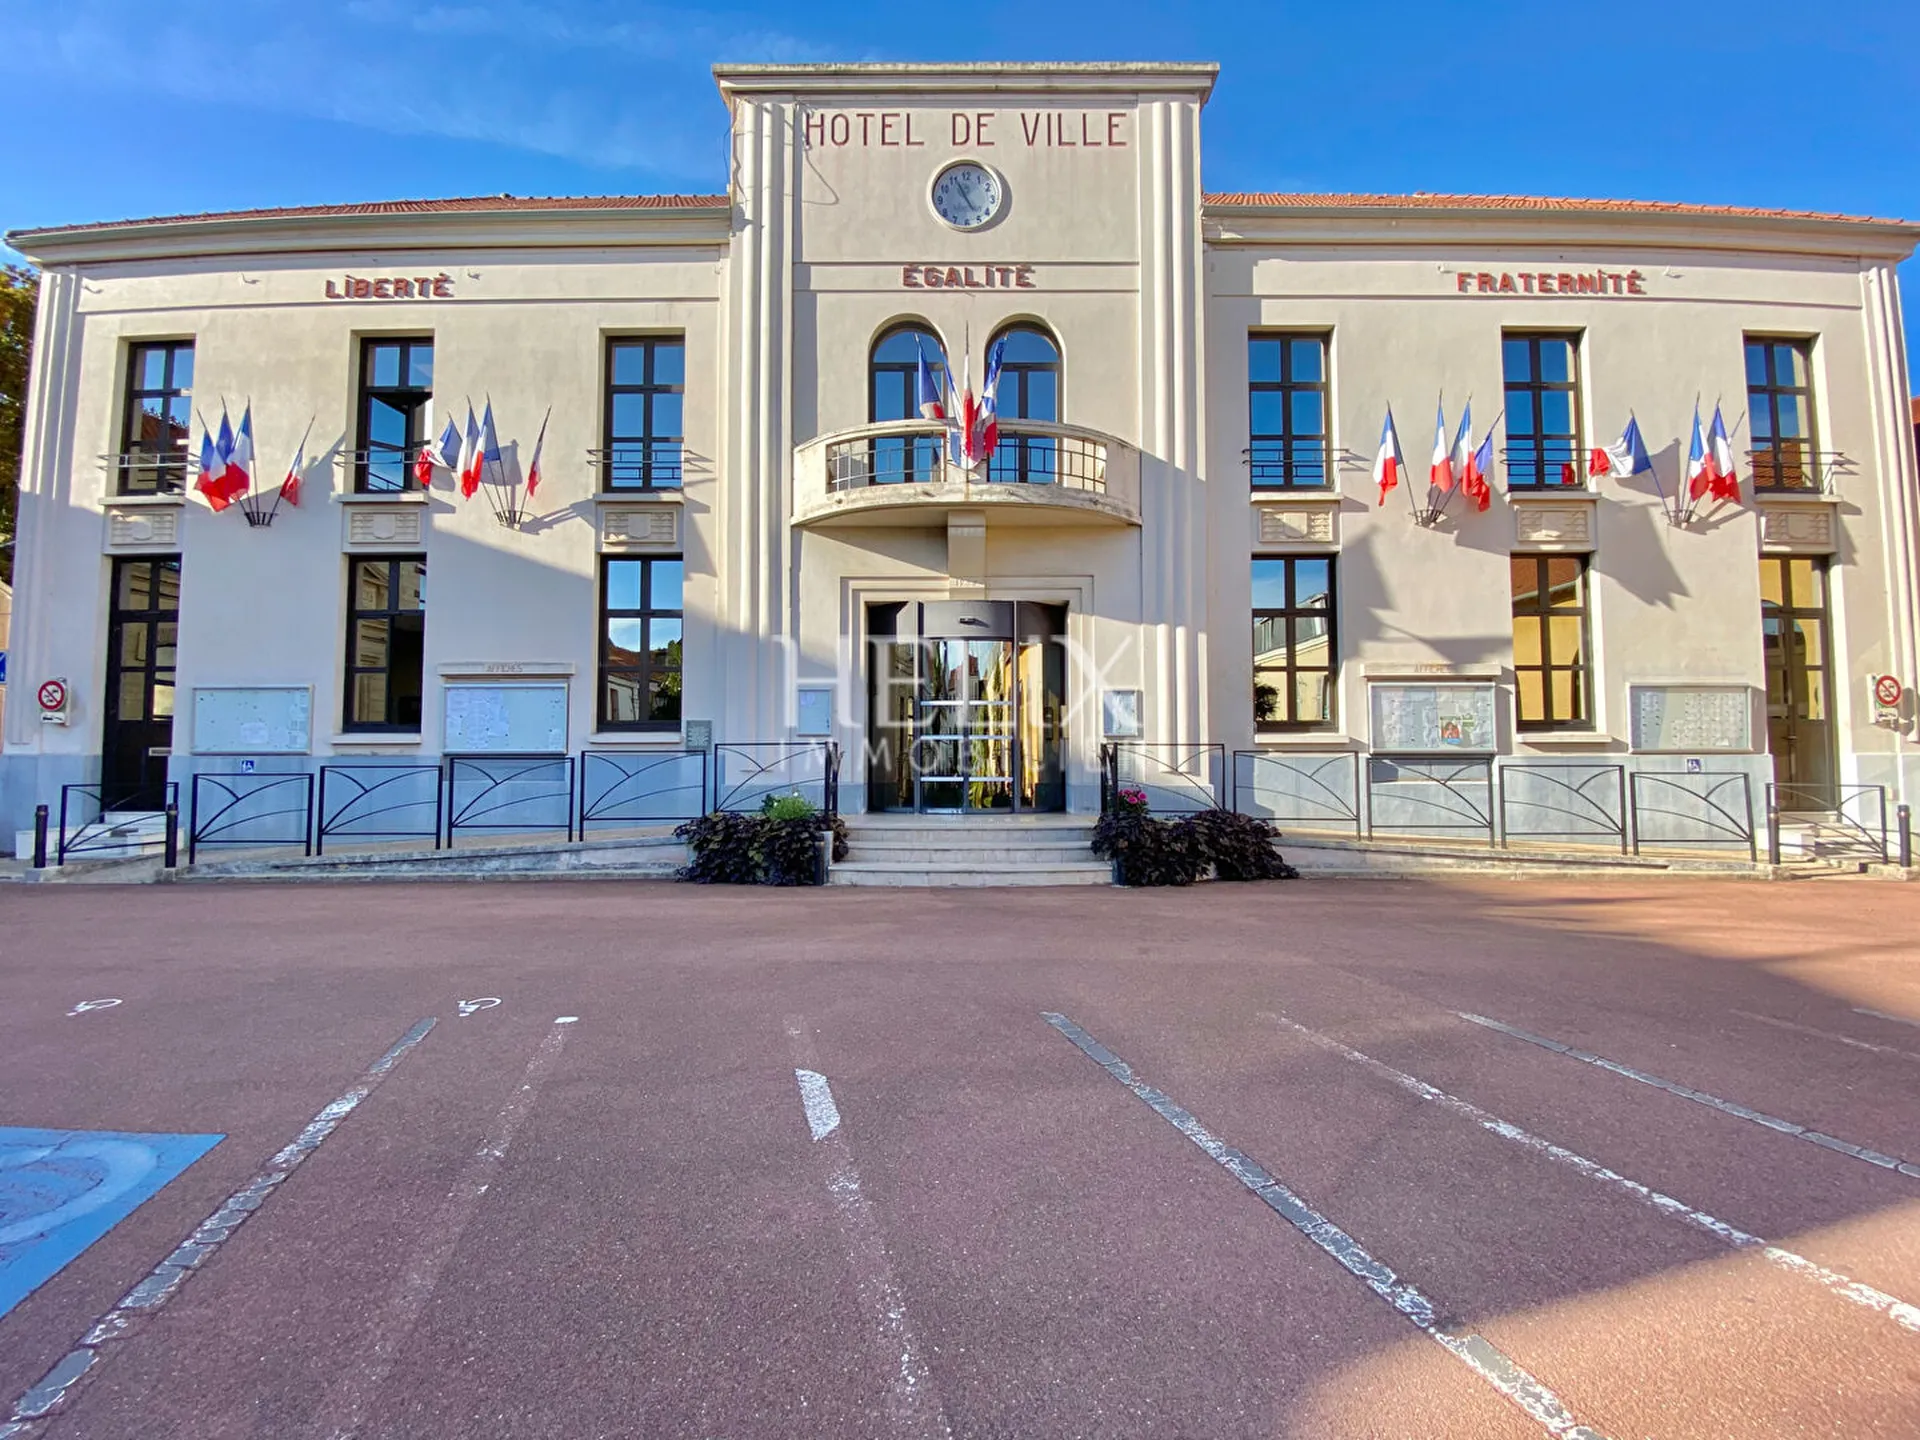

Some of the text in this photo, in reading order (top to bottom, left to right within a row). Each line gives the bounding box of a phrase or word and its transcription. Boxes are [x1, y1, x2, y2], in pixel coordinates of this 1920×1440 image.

[805, 113, 1127, 146] HOTEL DE VILLE
[961, 170, 971, 180] 12
[985, 182, 991, 192] 2
